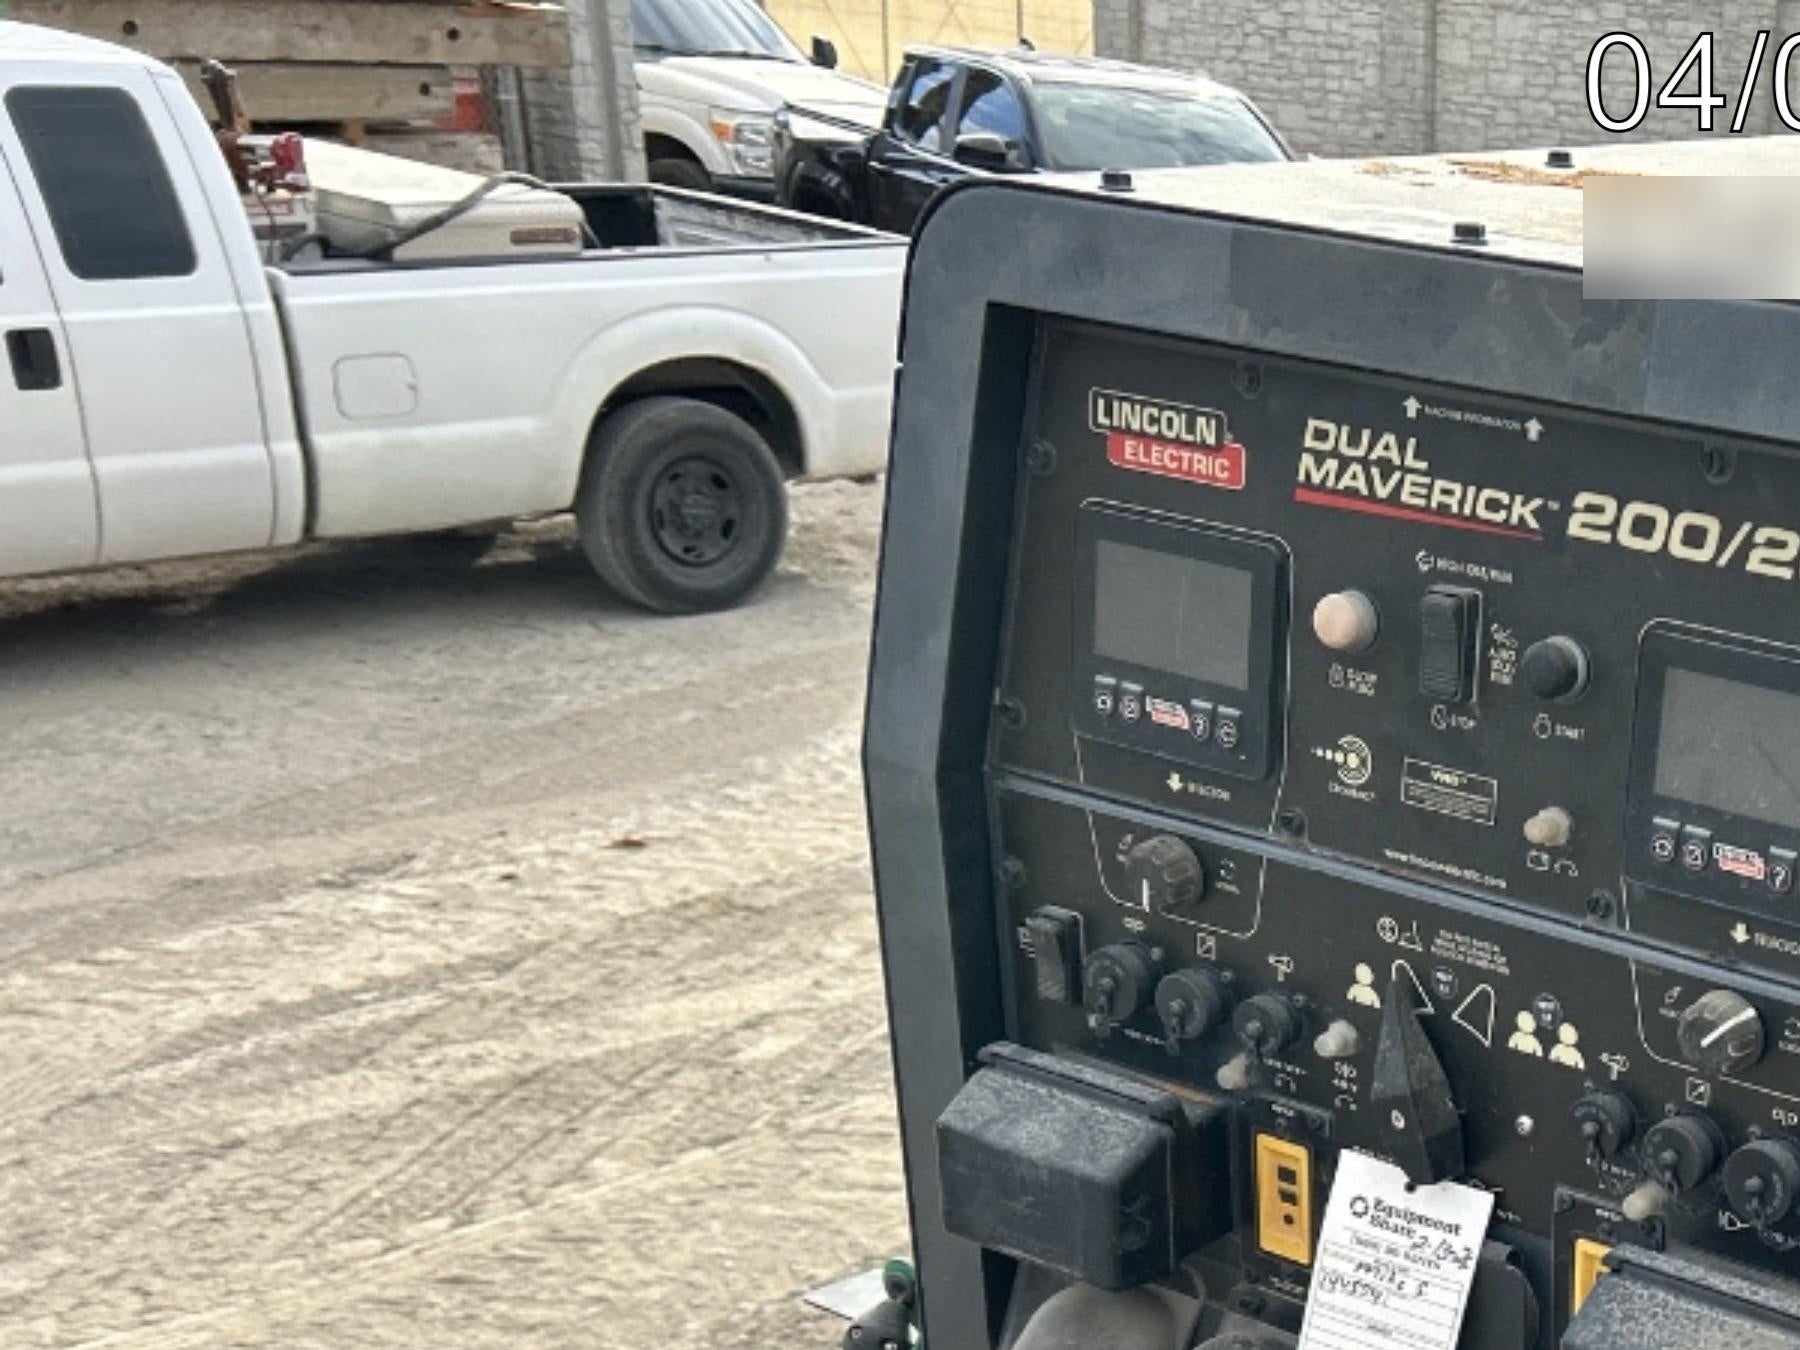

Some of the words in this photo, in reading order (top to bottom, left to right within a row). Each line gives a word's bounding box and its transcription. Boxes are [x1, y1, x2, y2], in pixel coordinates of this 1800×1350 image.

[1096, 398, 1218, 446] LINCOLN
[1303, 416, 1430, 470] DUAL
[1123, 440, 1231, 481] ELECTRIC
[1298, 452, 1543, 530] MAVERICK
[1373, 1197, 1462, 1237] Equipment
